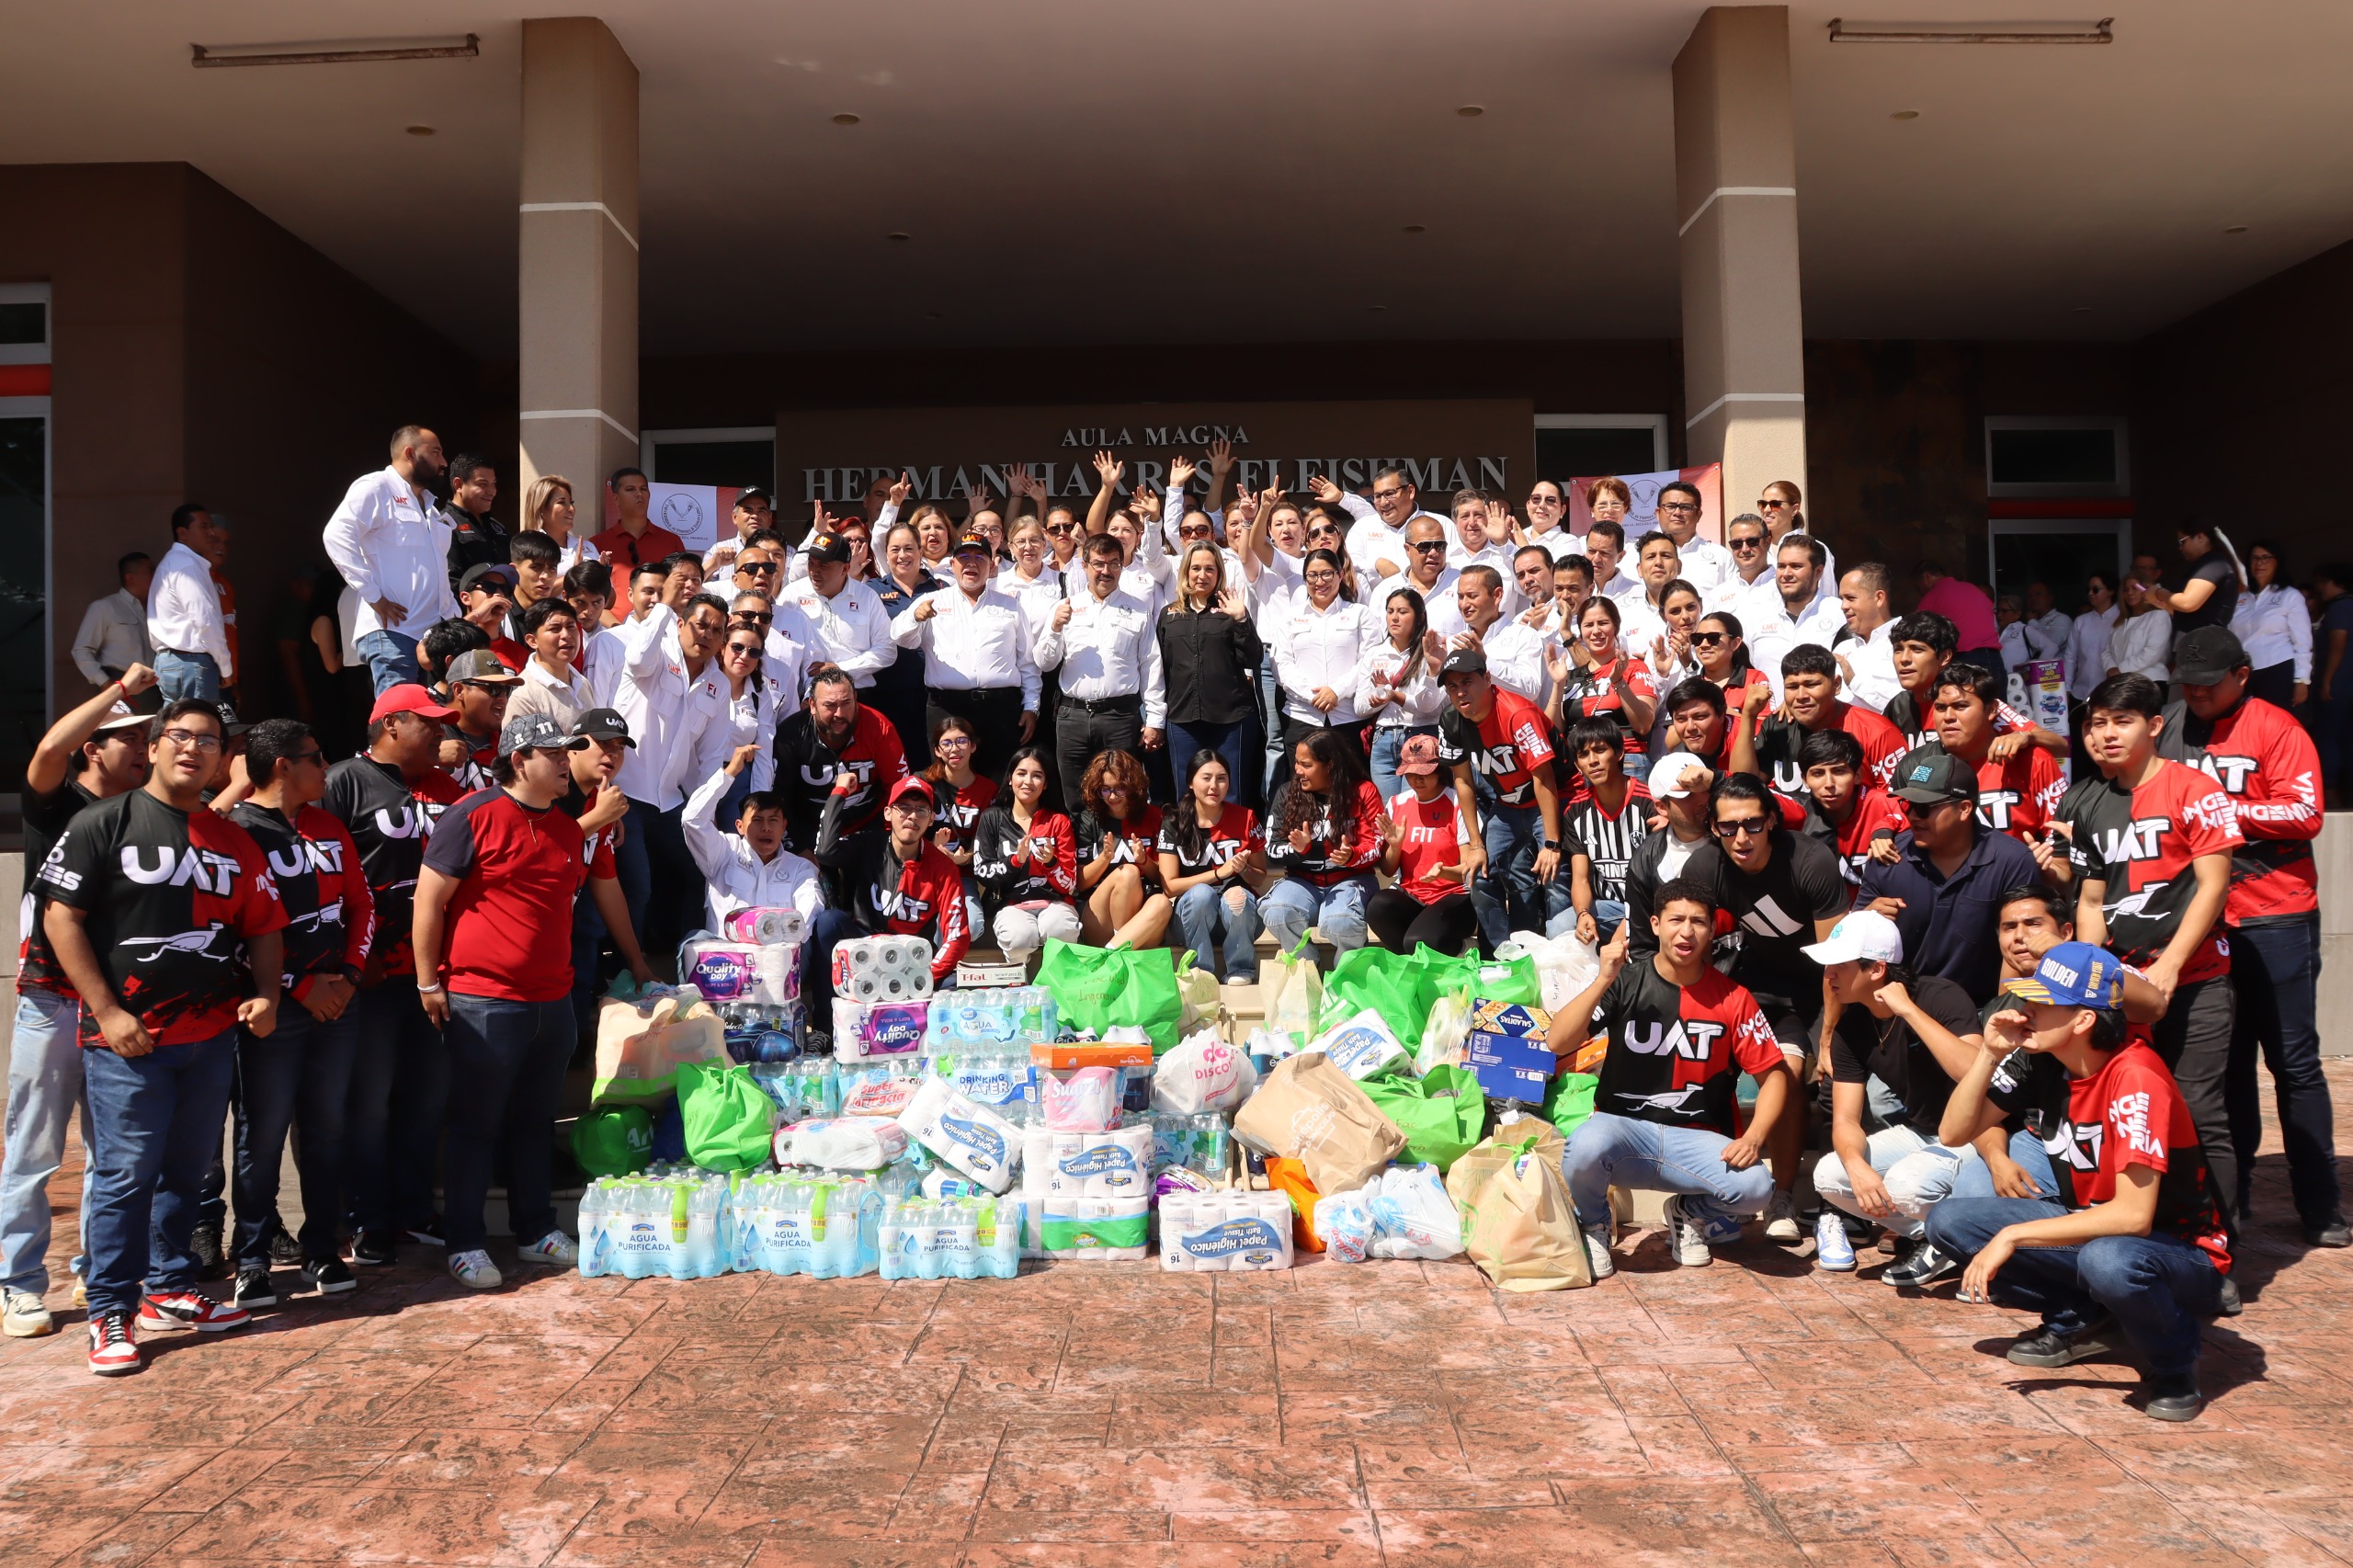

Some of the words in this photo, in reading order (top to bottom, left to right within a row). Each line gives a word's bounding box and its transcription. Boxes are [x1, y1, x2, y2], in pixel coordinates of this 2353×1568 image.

[1061, 427, 1134, 447] AULA
[1144, 425, 1250, 446] MAGNA
[800, 598, 817, 607] UAT
[1721, 594, 1735, 602] UAT
[1625, 627, 1640, 636] UAT
[1443, 657, 1460, 668] UAT
[536, 722, 553, 734] 11
[606, 717, 625, 730] UAT
[801, 762, 875, 786] UAT
[1410, 826, 1437, 843] FIT
[2093, 819, 2169, 865] UAT
[267, 840, 343, 877] UAT
[1176, 839, 1241, 868] UAT
[121, 845, 242, 896] UAT
[870, 883, 929, 923] UAT
[696, 962, 742, 977] Quality
[2040, 958, 2079, 988] GOLDEN
[961, 973, 986, 982] T-fal
[963, 1020, 993, 1030] AGUA
[1499, 1016, 1533, 1028] SALADITAS
[874, 1029, 920, 1044] Quality
[1624, 1018, 1724, 1059] UAT
[1349, 1037, 1370, 1058] Papel
[860, 1082, 894, 1095] Super
[957, 1081, 1010, 1096] WATER
[922, 1127, 934, 1139] 16
[944, 1122, 977, 1149] Higiénico
[970, 1128, 986, 1140] Tissue
[984, 1134, 998, 1145] Bath
[976, 1139, 998, 1155] Papel
[1065, 1160, 1103, 1174] Higiénico
[1104, 1158, 1126, 1171] Papel
[1051, 1181, 1062, 1190] 16
[1223, 1229, 1245, 1237] Tissue
[1245, 1226, 1261, 1236] Bath
[630, 1234, 657, 1243] AGUA
[766, 1237, 812, 1248] PURIFICADA
[1239, 1234, 1268, 1246] Papel
[618, 1241, 671, 1251] PURIFICADA
[1190, 1238, 1237, 1253] Higiénico
[1170, 1255, 1181, 1264] 16
